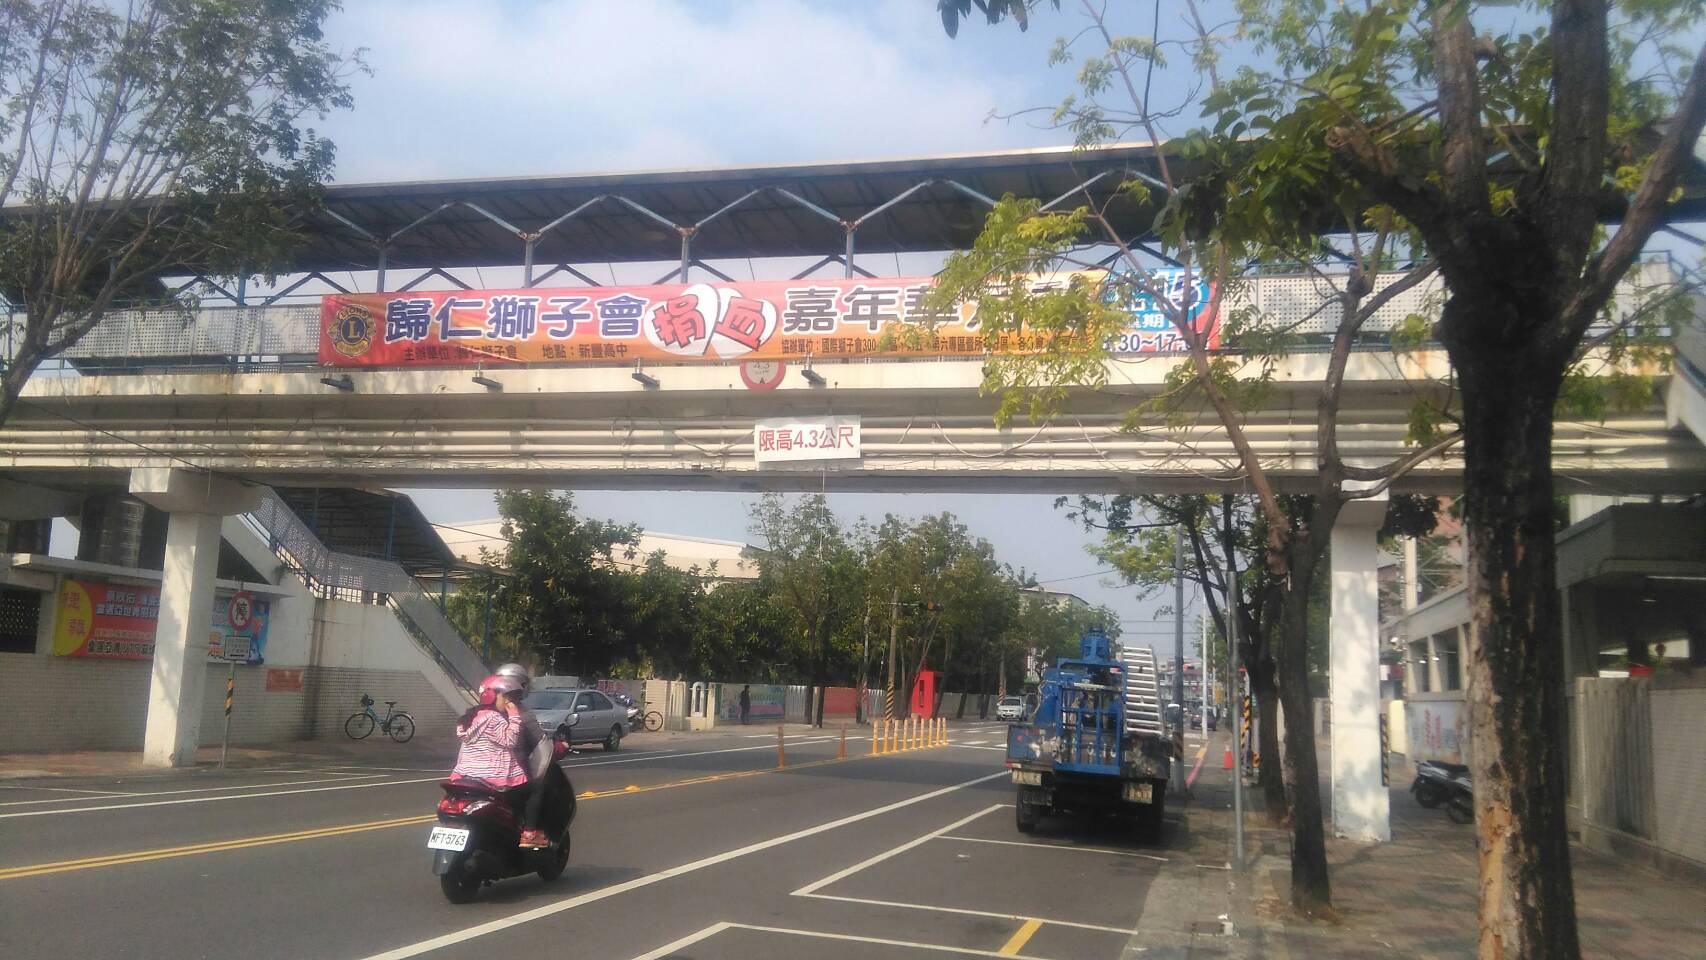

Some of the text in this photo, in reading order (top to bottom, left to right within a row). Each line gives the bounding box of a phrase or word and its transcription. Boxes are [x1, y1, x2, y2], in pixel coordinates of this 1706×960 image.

[384, 295, 649, 344] 歸仁獅子會
[652, 294, 766, 351] 捐血
[759, 426, 854, 451] 限高4.3公尺
